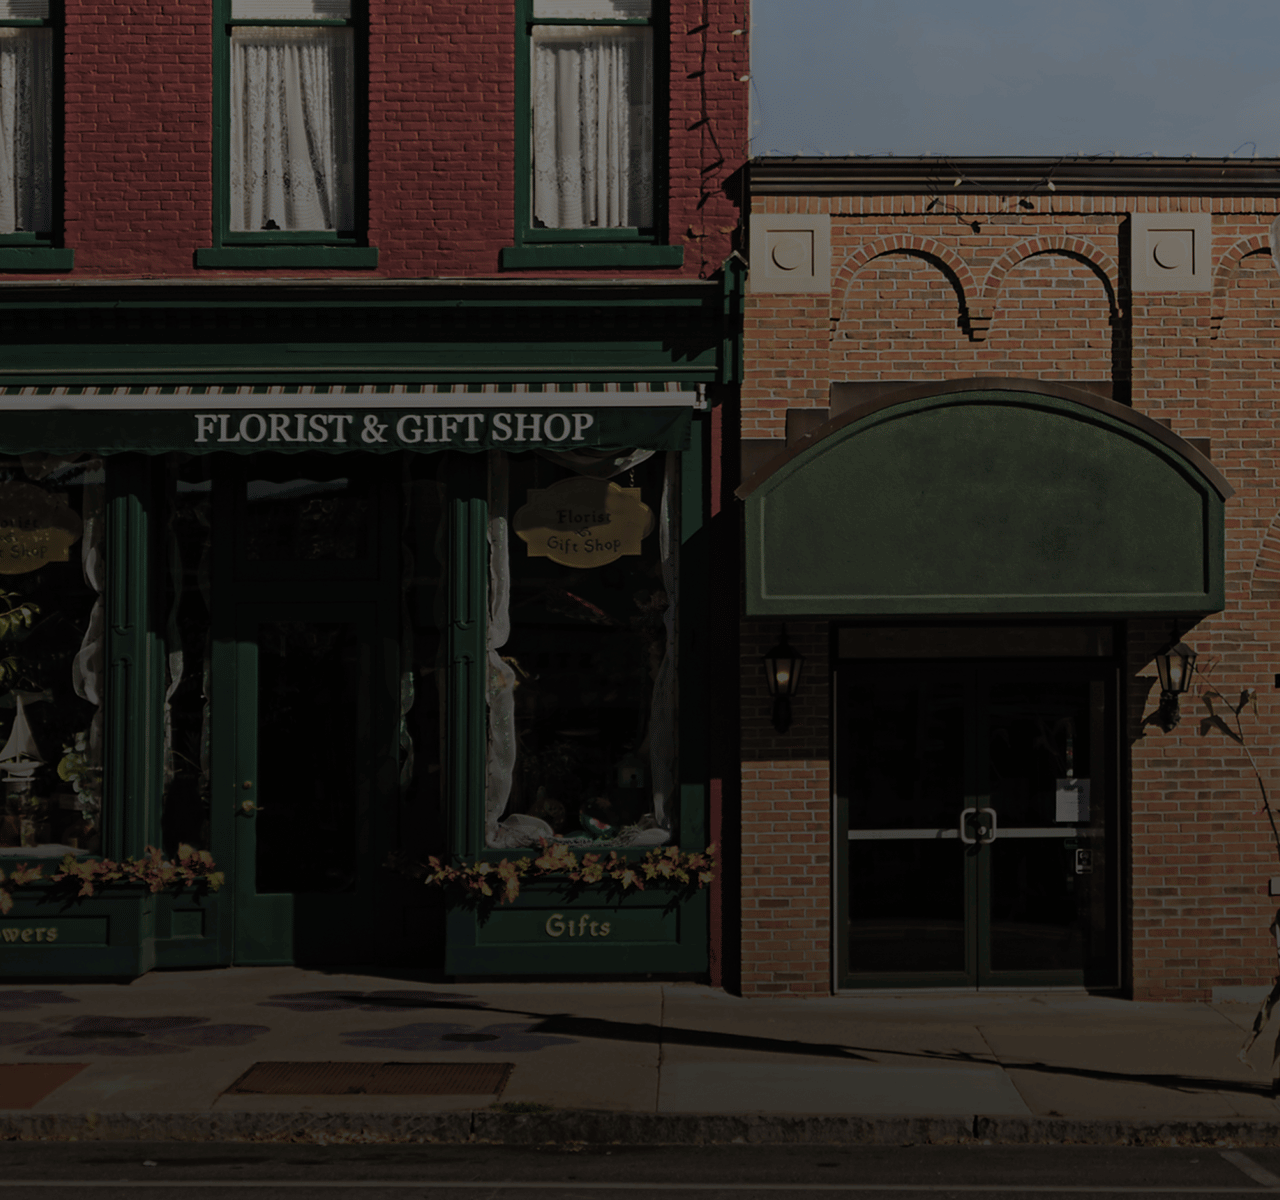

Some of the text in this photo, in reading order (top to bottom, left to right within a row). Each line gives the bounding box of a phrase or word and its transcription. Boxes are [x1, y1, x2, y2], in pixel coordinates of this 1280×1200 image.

[194, 413, 594, 443] FLORIST & GIFT SHOP
[557, 509, 611, 523] Florist
[10, 543, 48, 559] Shop
[547, 536, 621, 553] Gift Shop
[545, 914, 611, 938] Gifts
